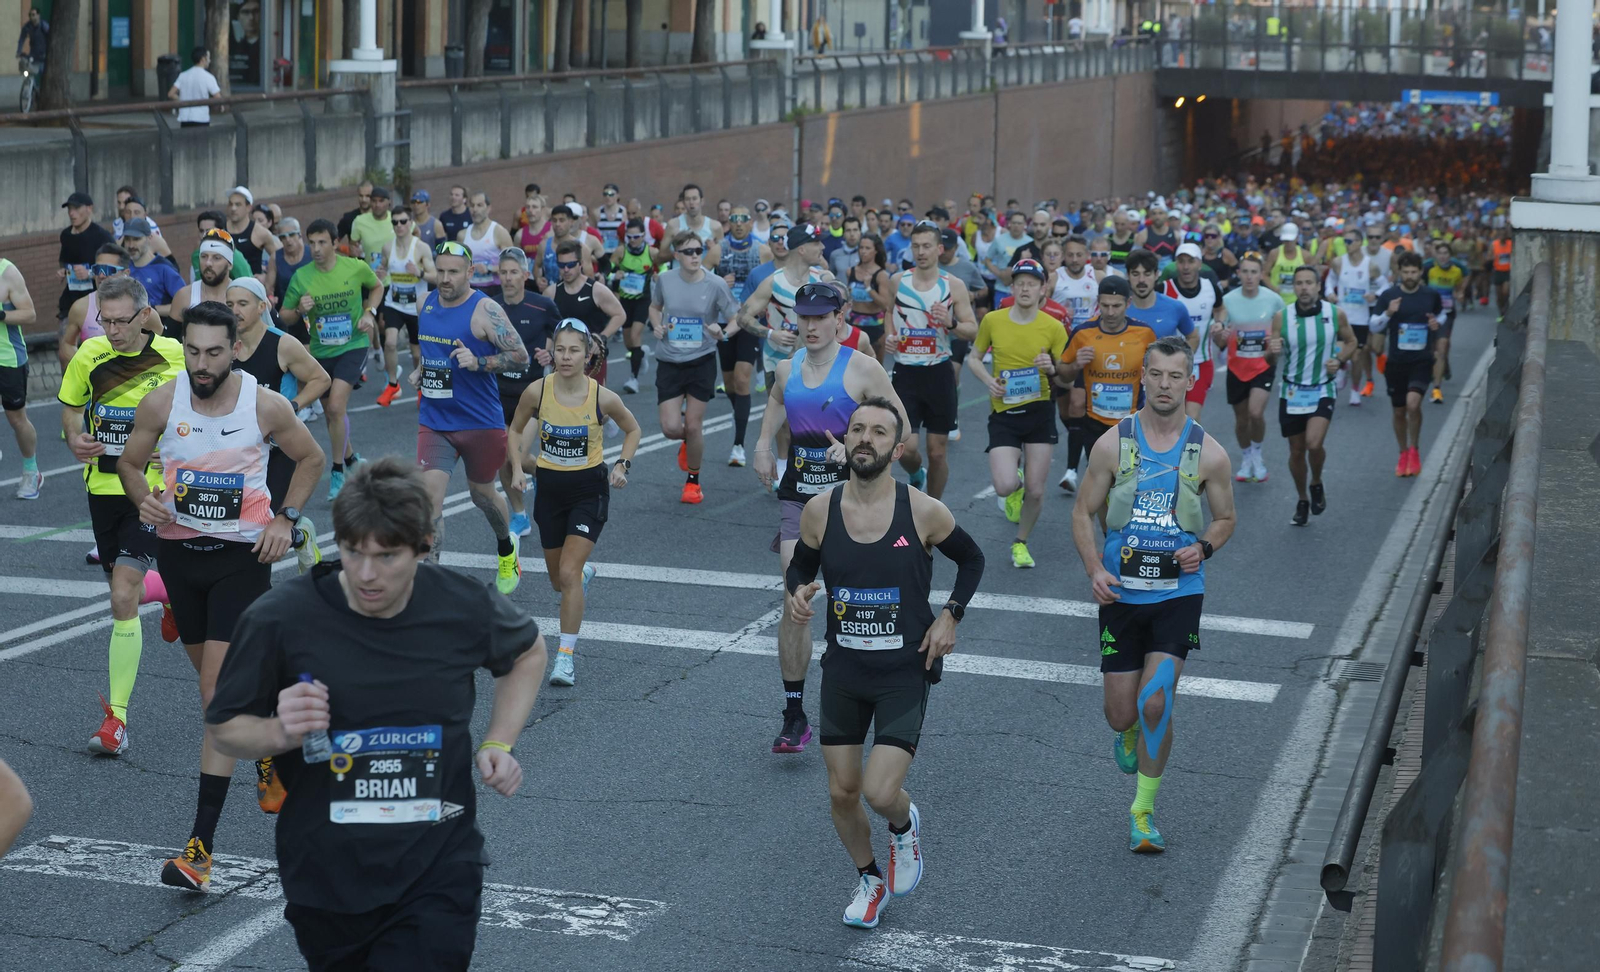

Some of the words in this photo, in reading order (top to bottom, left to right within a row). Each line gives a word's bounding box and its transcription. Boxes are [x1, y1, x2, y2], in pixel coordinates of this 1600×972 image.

[322, 289, 354, 299] RUNNING
[316, 299, 348, 311] sano
[425, 358, 447, 366] ZURICH
[1012, 369, 1034, 377] ZURICH
[1010, 386, 1032, 395] ROBIN
[97, 431, 131, 443] PHILIP
[545, 443, 584, 457] MARIEKE
[809, 451, 826, 459] ZURI
[199, 475, 236, 485] ZURICH
[803, 472, 839, 484] ROBBIE
[198, 493, 219, 503] 3870
[188, 503, 227, 519] DAVID
[1142, 540, 1175, 548] ZURICH
[1142, 555, 1160, 564] 3568
[1139, 565, 1161, 578] SEB
[854, 592, 892, 601] ZURICH
[856, 610, 875, 619] 4197
[841, 620, 895, 635] ESEROLO
[368, 733, 428, 746] ZURICH
[369, 759, 402, 773] 2955
[355, 777, 417, 798] BRIAN
